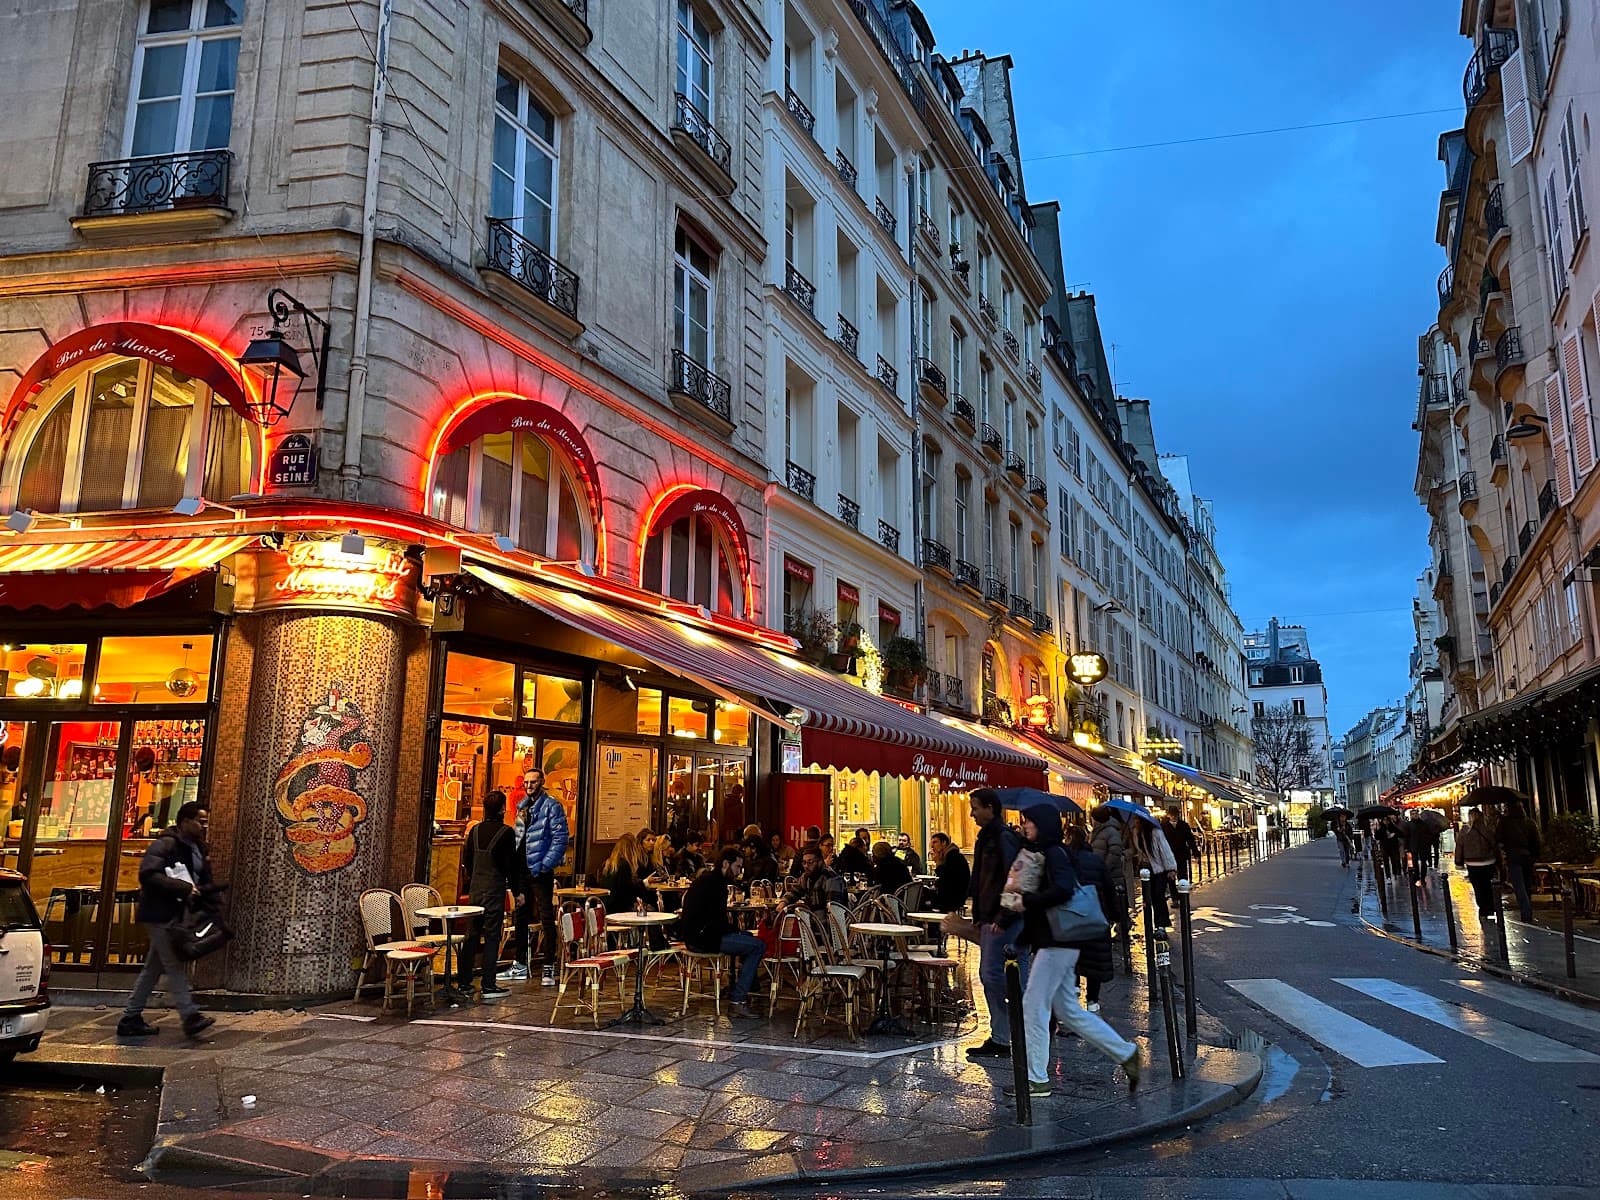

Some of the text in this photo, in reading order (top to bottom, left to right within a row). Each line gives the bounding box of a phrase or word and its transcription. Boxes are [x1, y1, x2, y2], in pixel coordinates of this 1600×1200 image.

[56, 338, 175, 368] Bar du Marché
[511, 416, 533, 428] Bar
[537, 419, 551, 430] du
[282, 454, 305, 465] RUE
[275, 472, 310, 483] SEINE
[375, 551, 410, 576] du
[912, 753, 988, 782] Bar du Marché
